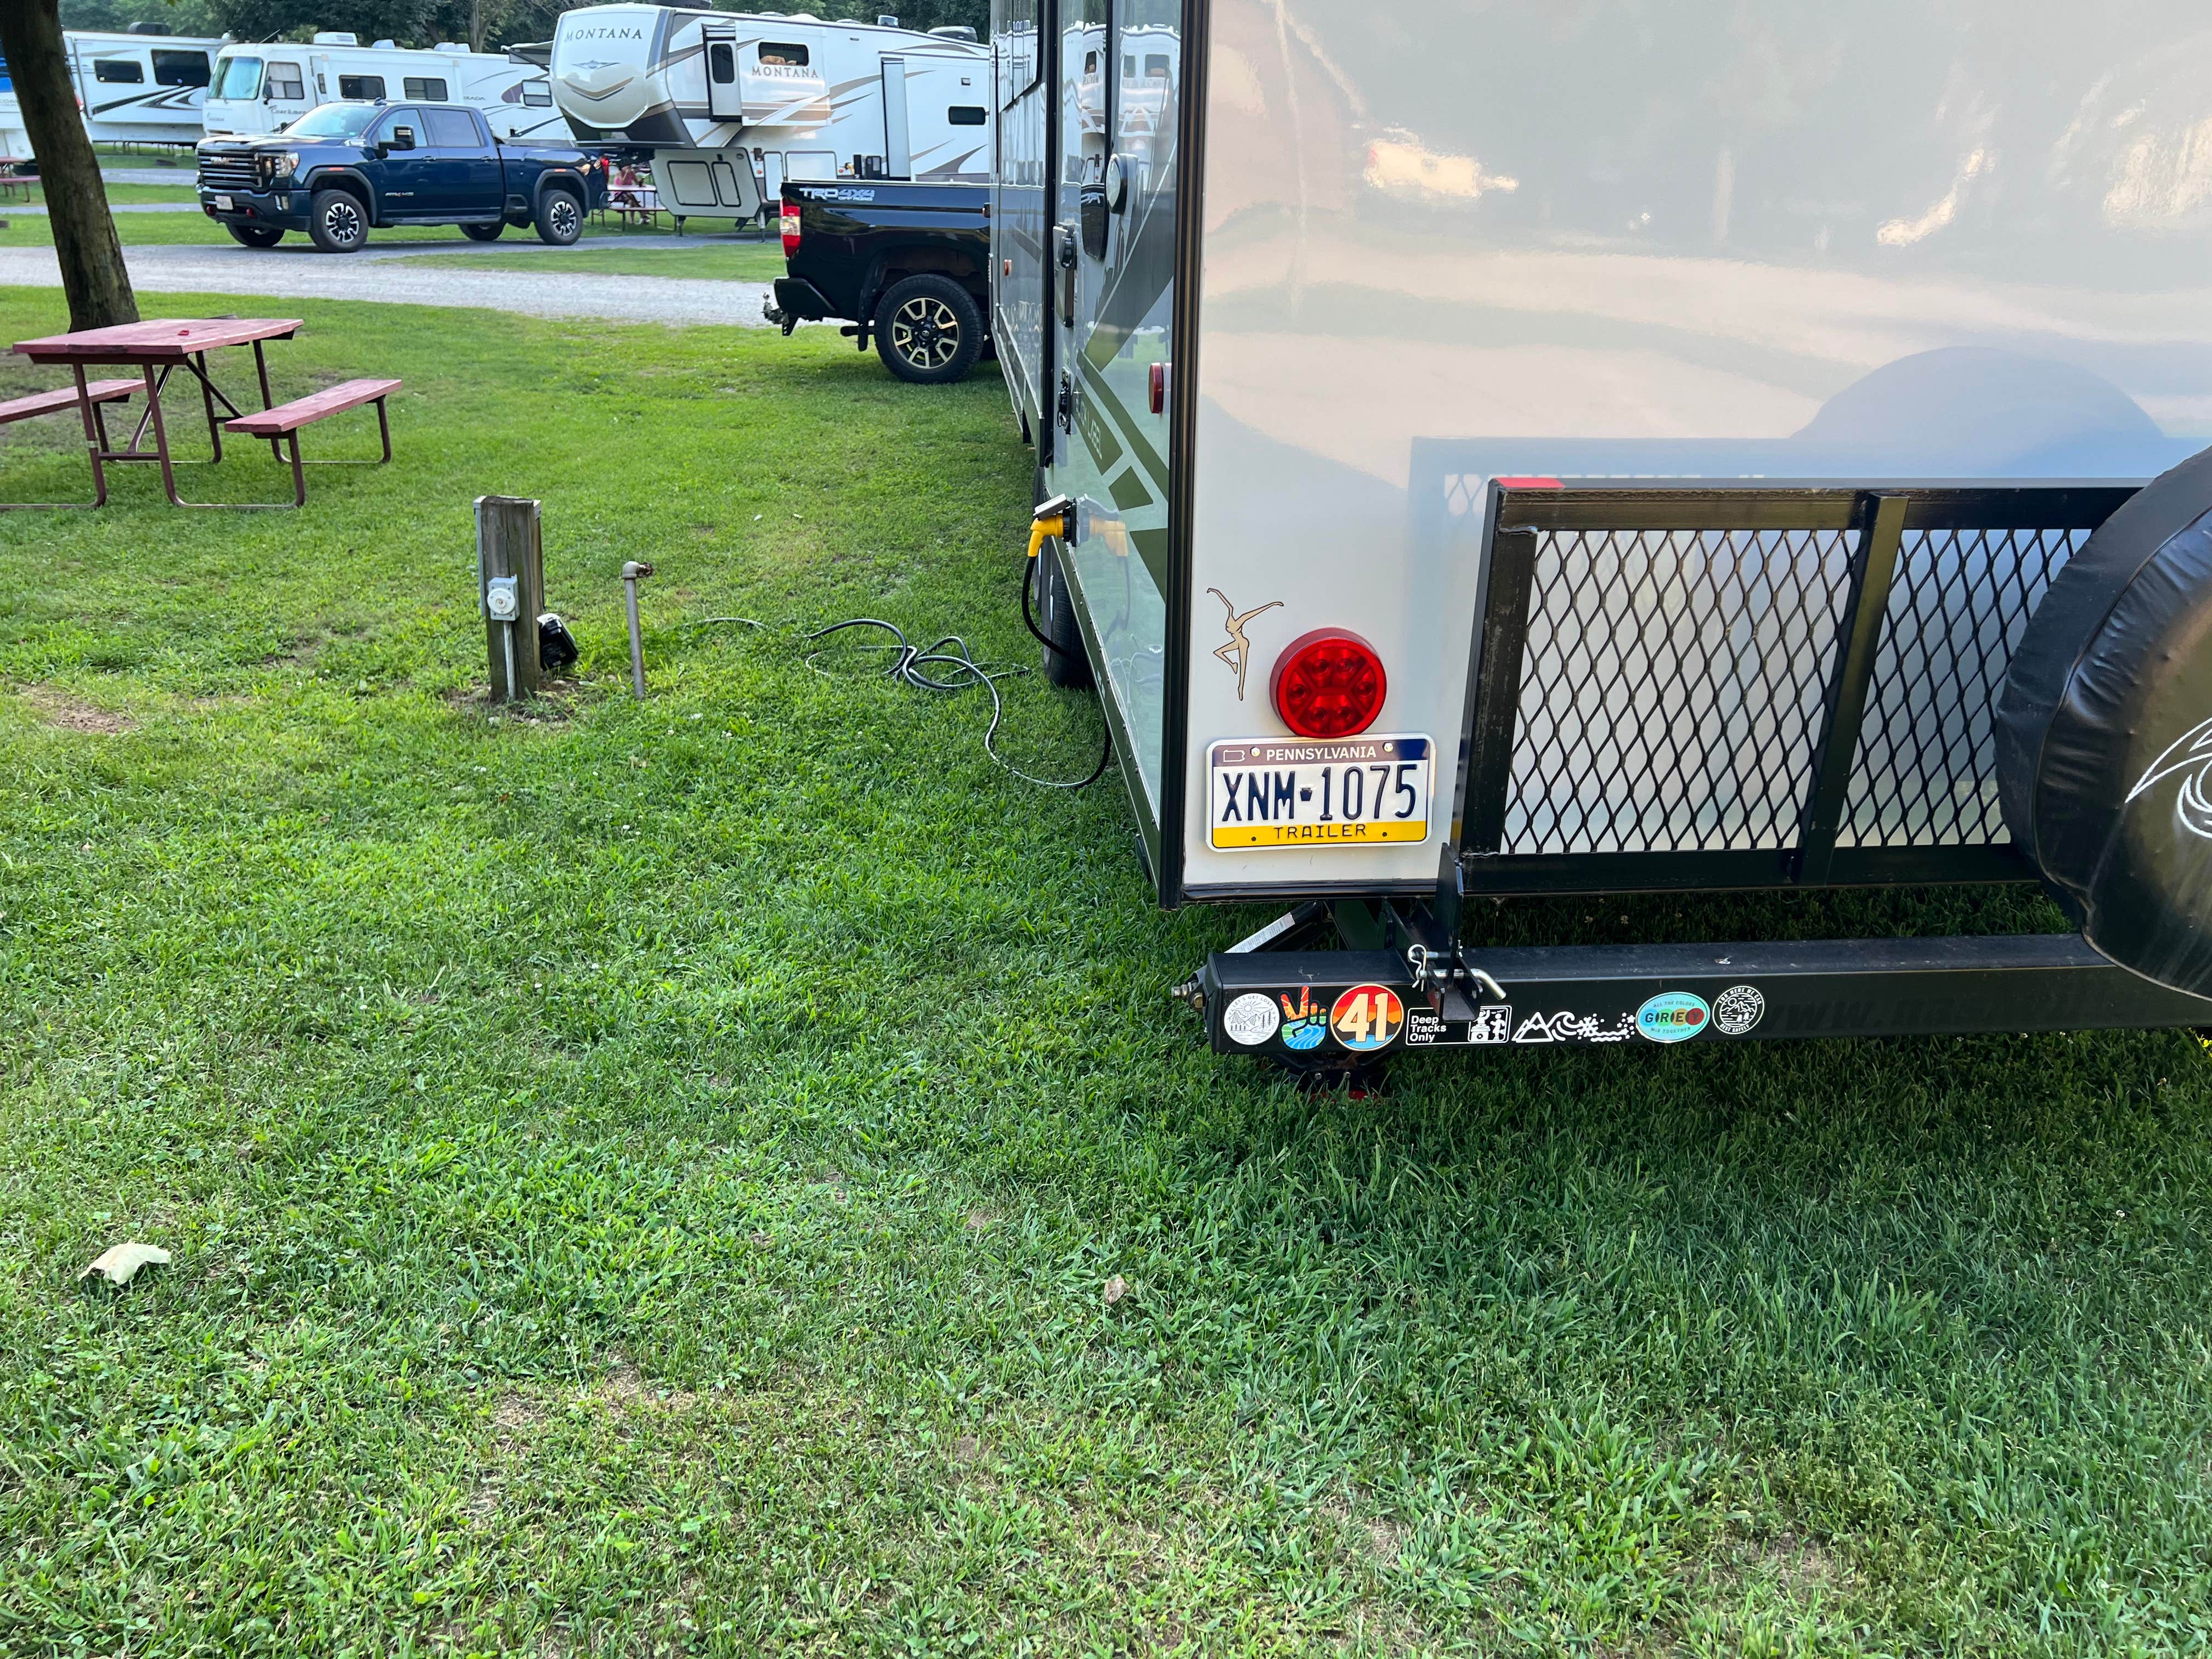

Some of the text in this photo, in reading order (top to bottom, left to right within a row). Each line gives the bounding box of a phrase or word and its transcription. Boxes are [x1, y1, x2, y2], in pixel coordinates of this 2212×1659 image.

[565, 28, 642, 42] MONTANA
[752, 66, 819, 77] MONTANA
[799, 188, 839, 200] TRD
[1266, 746, 1377, 761] PENNSYLVANIA
[1274, 824, 1367, 839] TRAILER
[1260, 997, 1273, 1006] LOST
[1336, 992, 1389, 1042] 41
[1411, 1015, 1439, 1025] Deep
[1410, 1024, 1447, 1032] Tracks
[1409, 1032, 1436, 1043] Only
